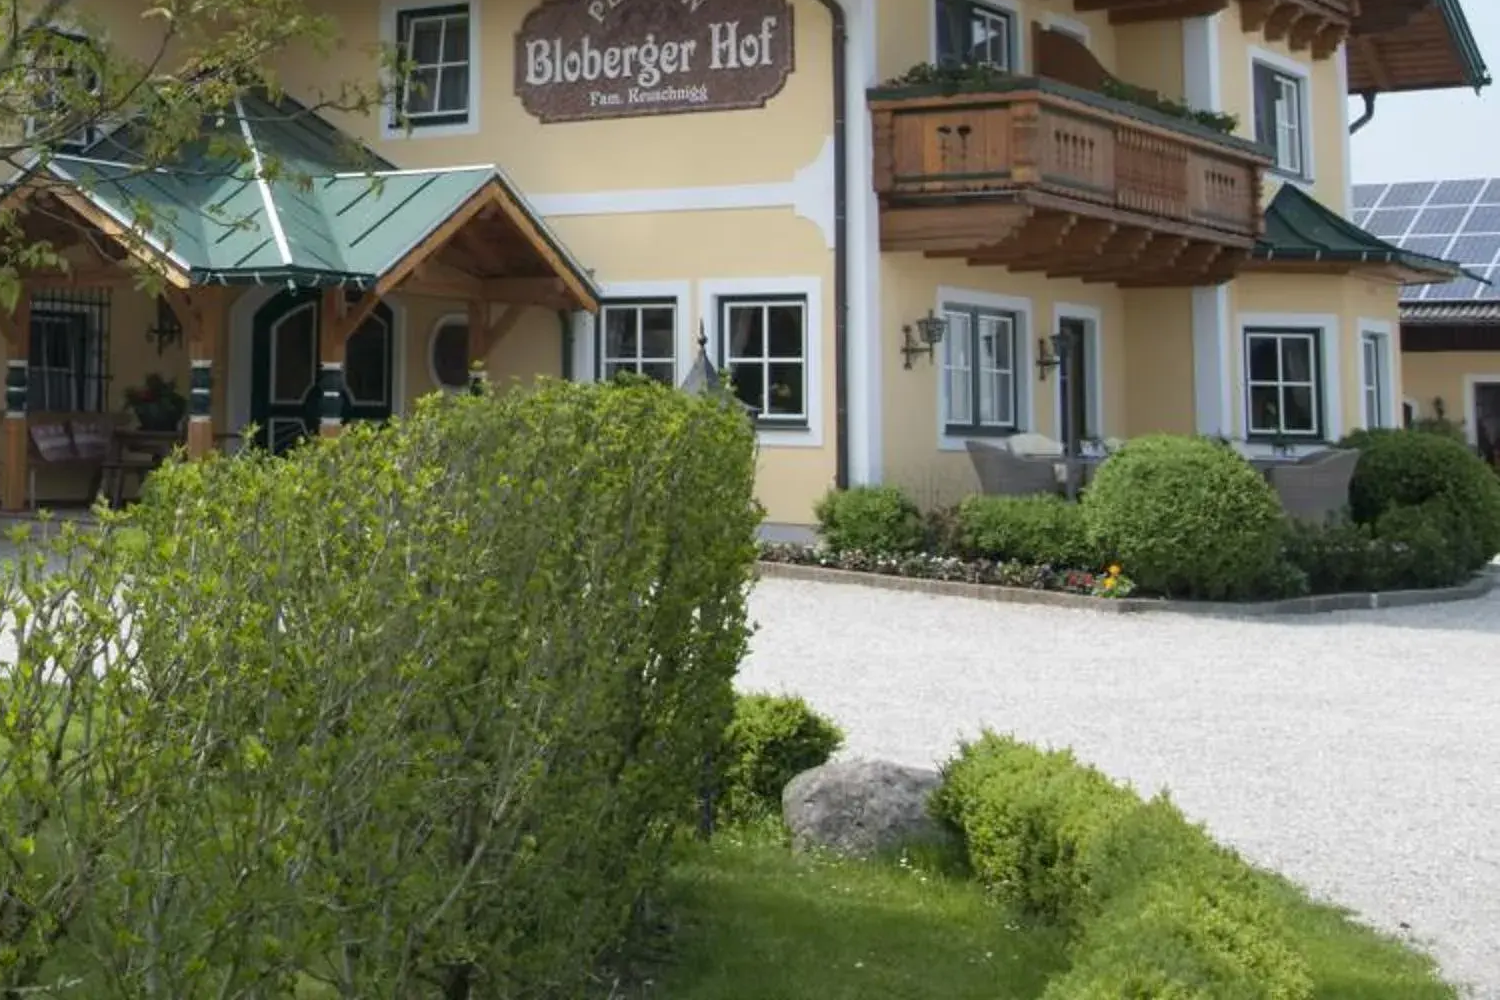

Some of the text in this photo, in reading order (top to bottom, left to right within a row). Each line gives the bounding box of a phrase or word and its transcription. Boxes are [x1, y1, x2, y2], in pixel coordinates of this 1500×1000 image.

[525, 16, 777, 87] Bloberger Hof
[589, 91, 623, 107] Fam.
